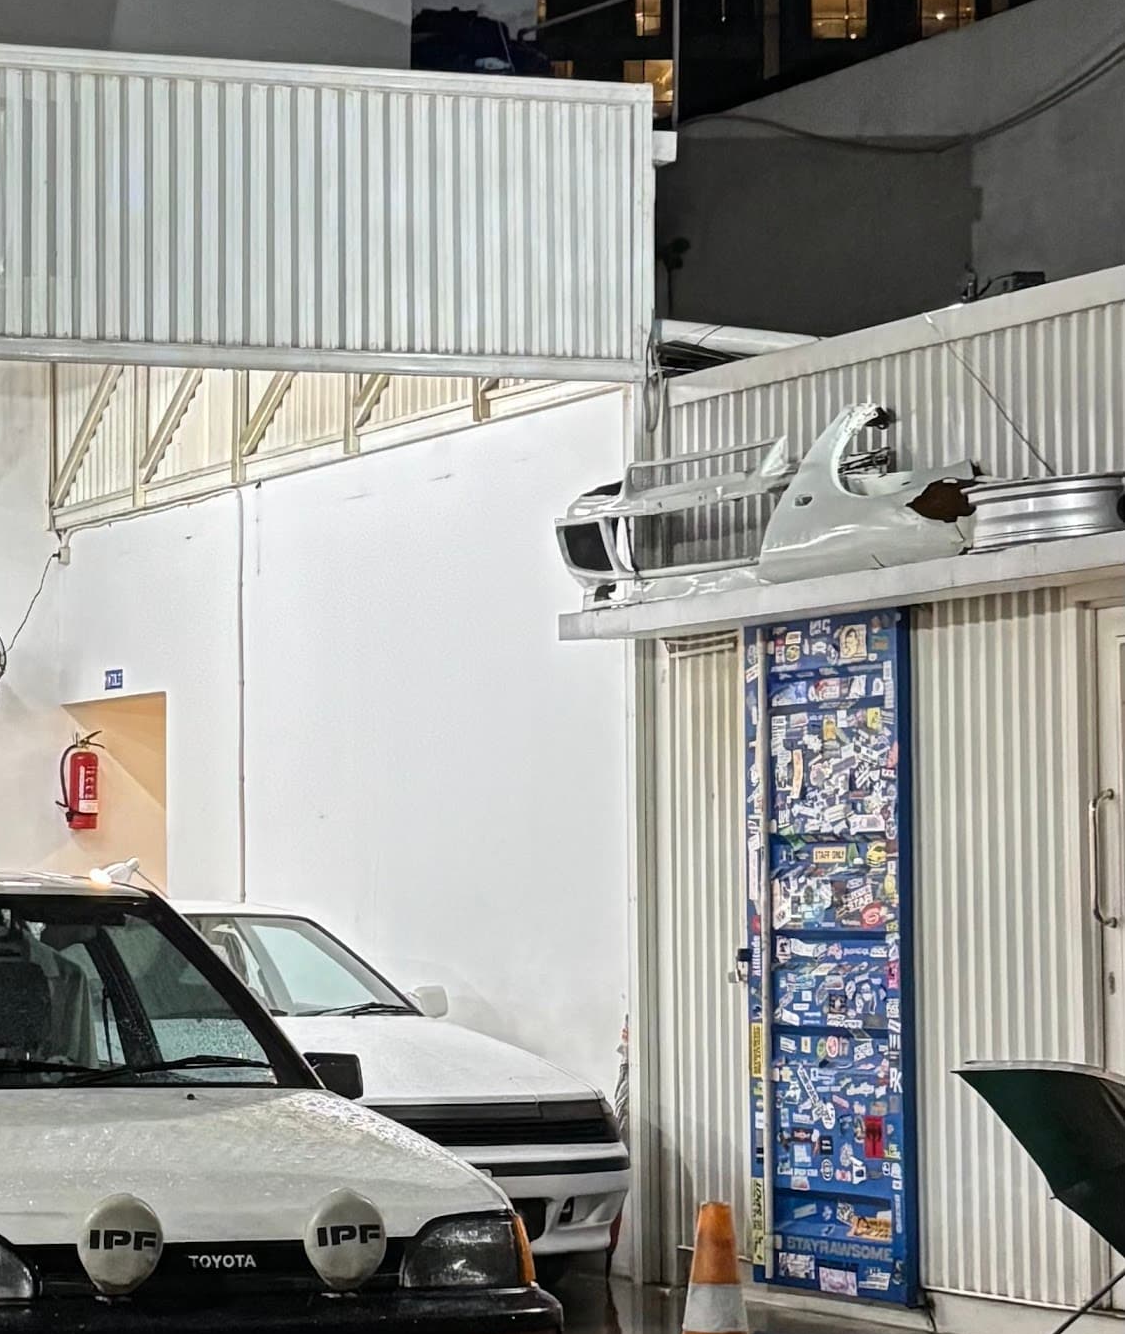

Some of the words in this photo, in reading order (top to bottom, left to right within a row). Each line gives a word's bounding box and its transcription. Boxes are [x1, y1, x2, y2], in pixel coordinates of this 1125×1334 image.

[89, 1229, 157, 1251] IPF
[317, 1224, 381, 1248] IPF
[188, 1254, 257, 1269] TOYOTA
